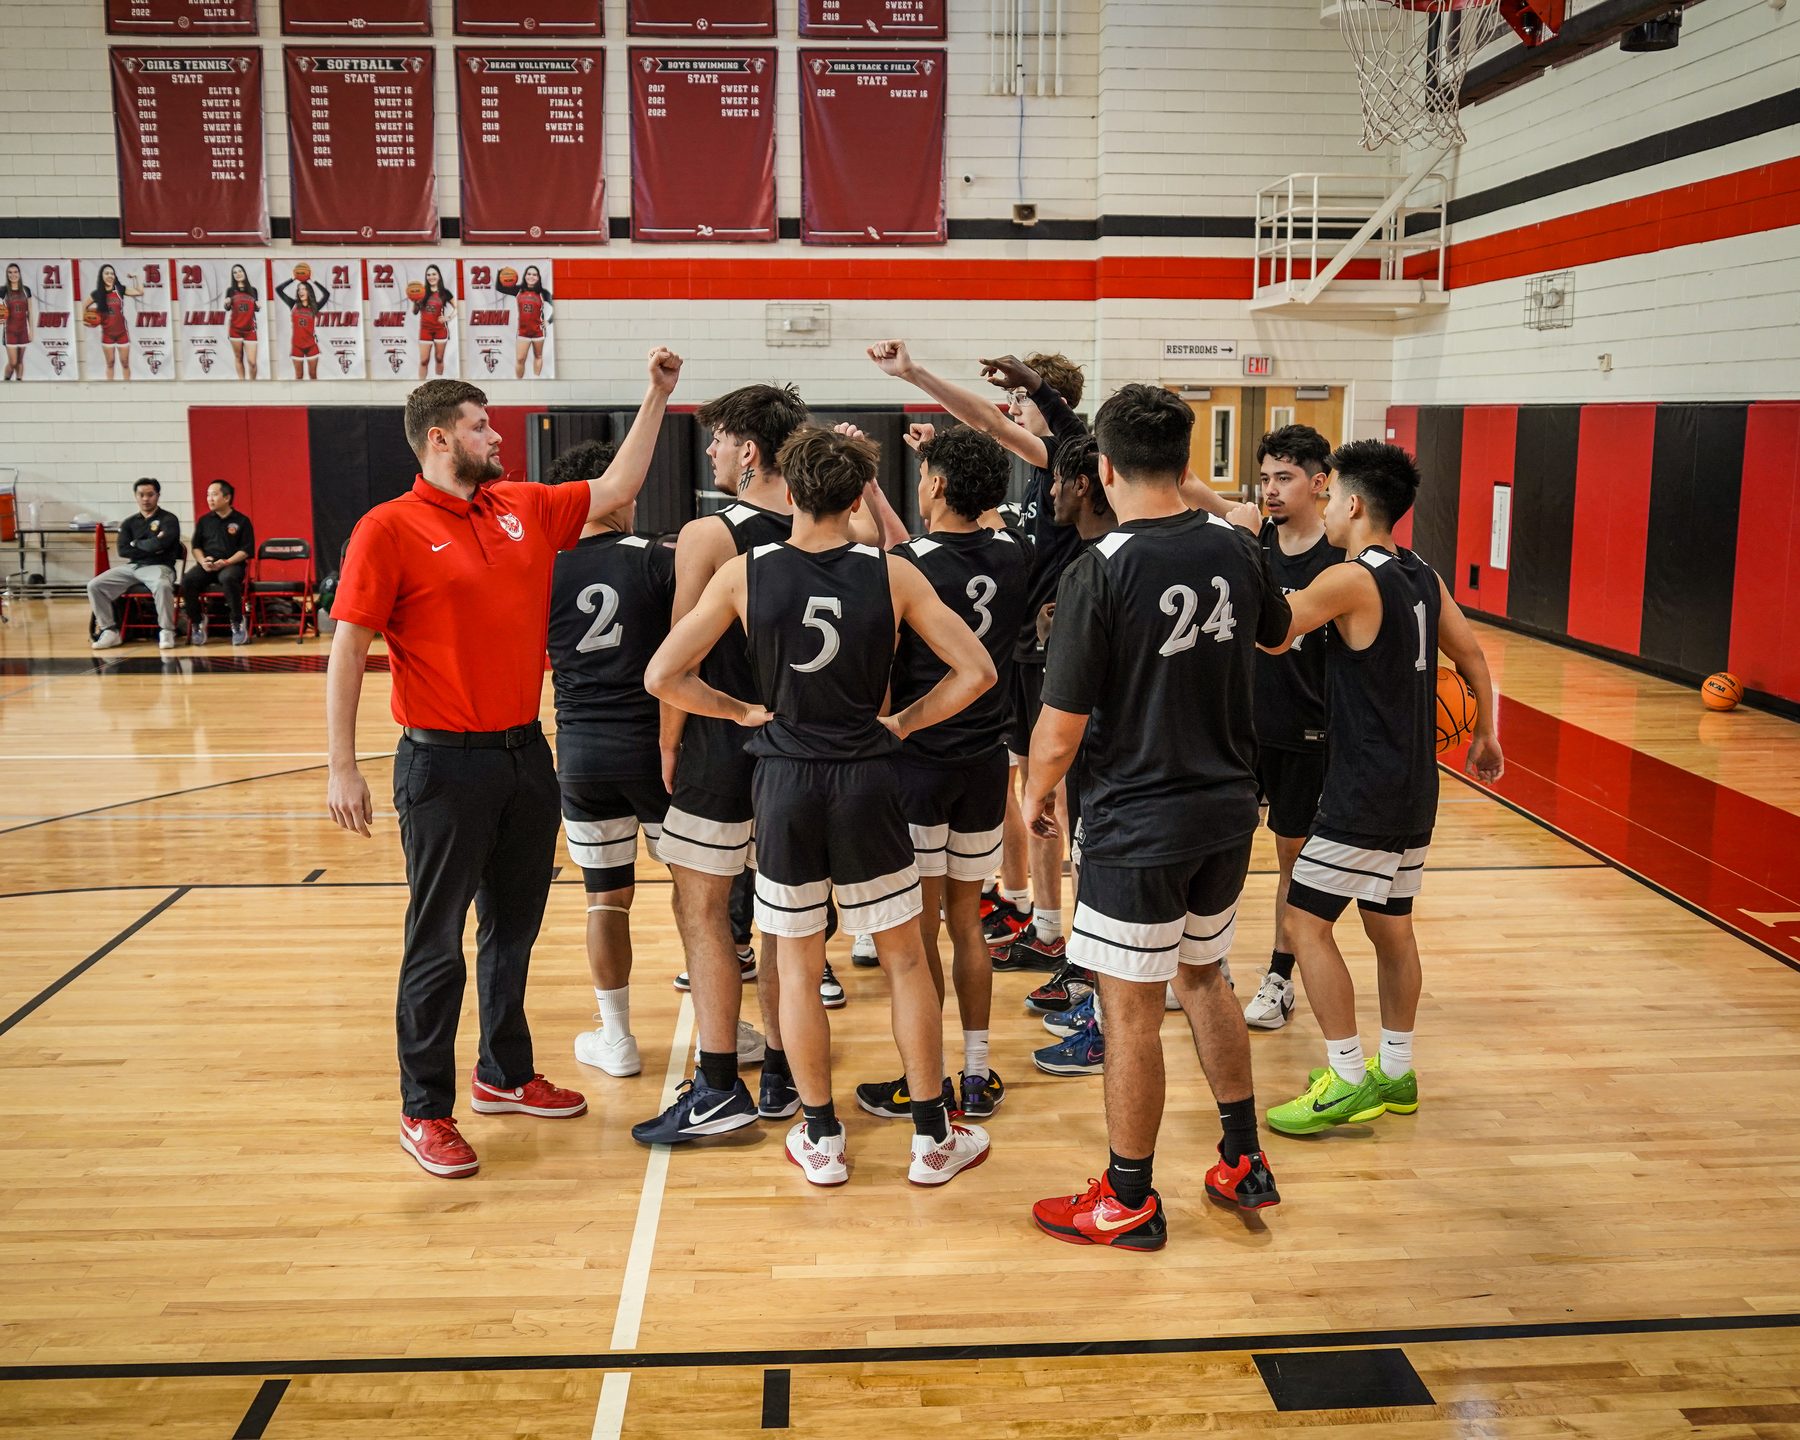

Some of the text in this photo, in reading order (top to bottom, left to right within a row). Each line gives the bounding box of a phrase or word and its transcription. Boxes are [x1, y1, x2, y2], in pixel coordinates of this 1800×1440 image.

[147, 60, 227, 70] GIRLS TENNIS
[327, 60, 394, 70] SOFTBALL
[171, 74, 203, 83] STATE
[344, 74, 376, 83] STATE
[515, 74, 546, 83] STATE
[688, 74, 719, 83] STATE
[857, 76, 888, 85] STATE
[374, 86, 401, 94] SWEET
[202, 99, 230, 107] SWEET
[374, 98, 402, 106] SWEET
[721, 109, 749, 117] SWEET
[377, 159, 405, 167] SWEET
[212, 172, 236, 180] FINAL
[43, 264, 60, 284] 21
[332, 265, 350, 284] 21
[373, 264, 394, 283] 22
[471, 266, 491, 285] 23
[316, 311, 360, 327] TAYLOR
[470, 310, 510, 326] EMMA
[1166, 345, 1218, 354] RESTROOMS
[1248, 357, 1270, 374] EXIT
[965, 574, 998, 640] 3
[576, 583, 624, 654] 2
[1158, 575, 1237, 657] 24
[789, 596, 842, 673] 5
[1413, 600, 1428, 671] 1
